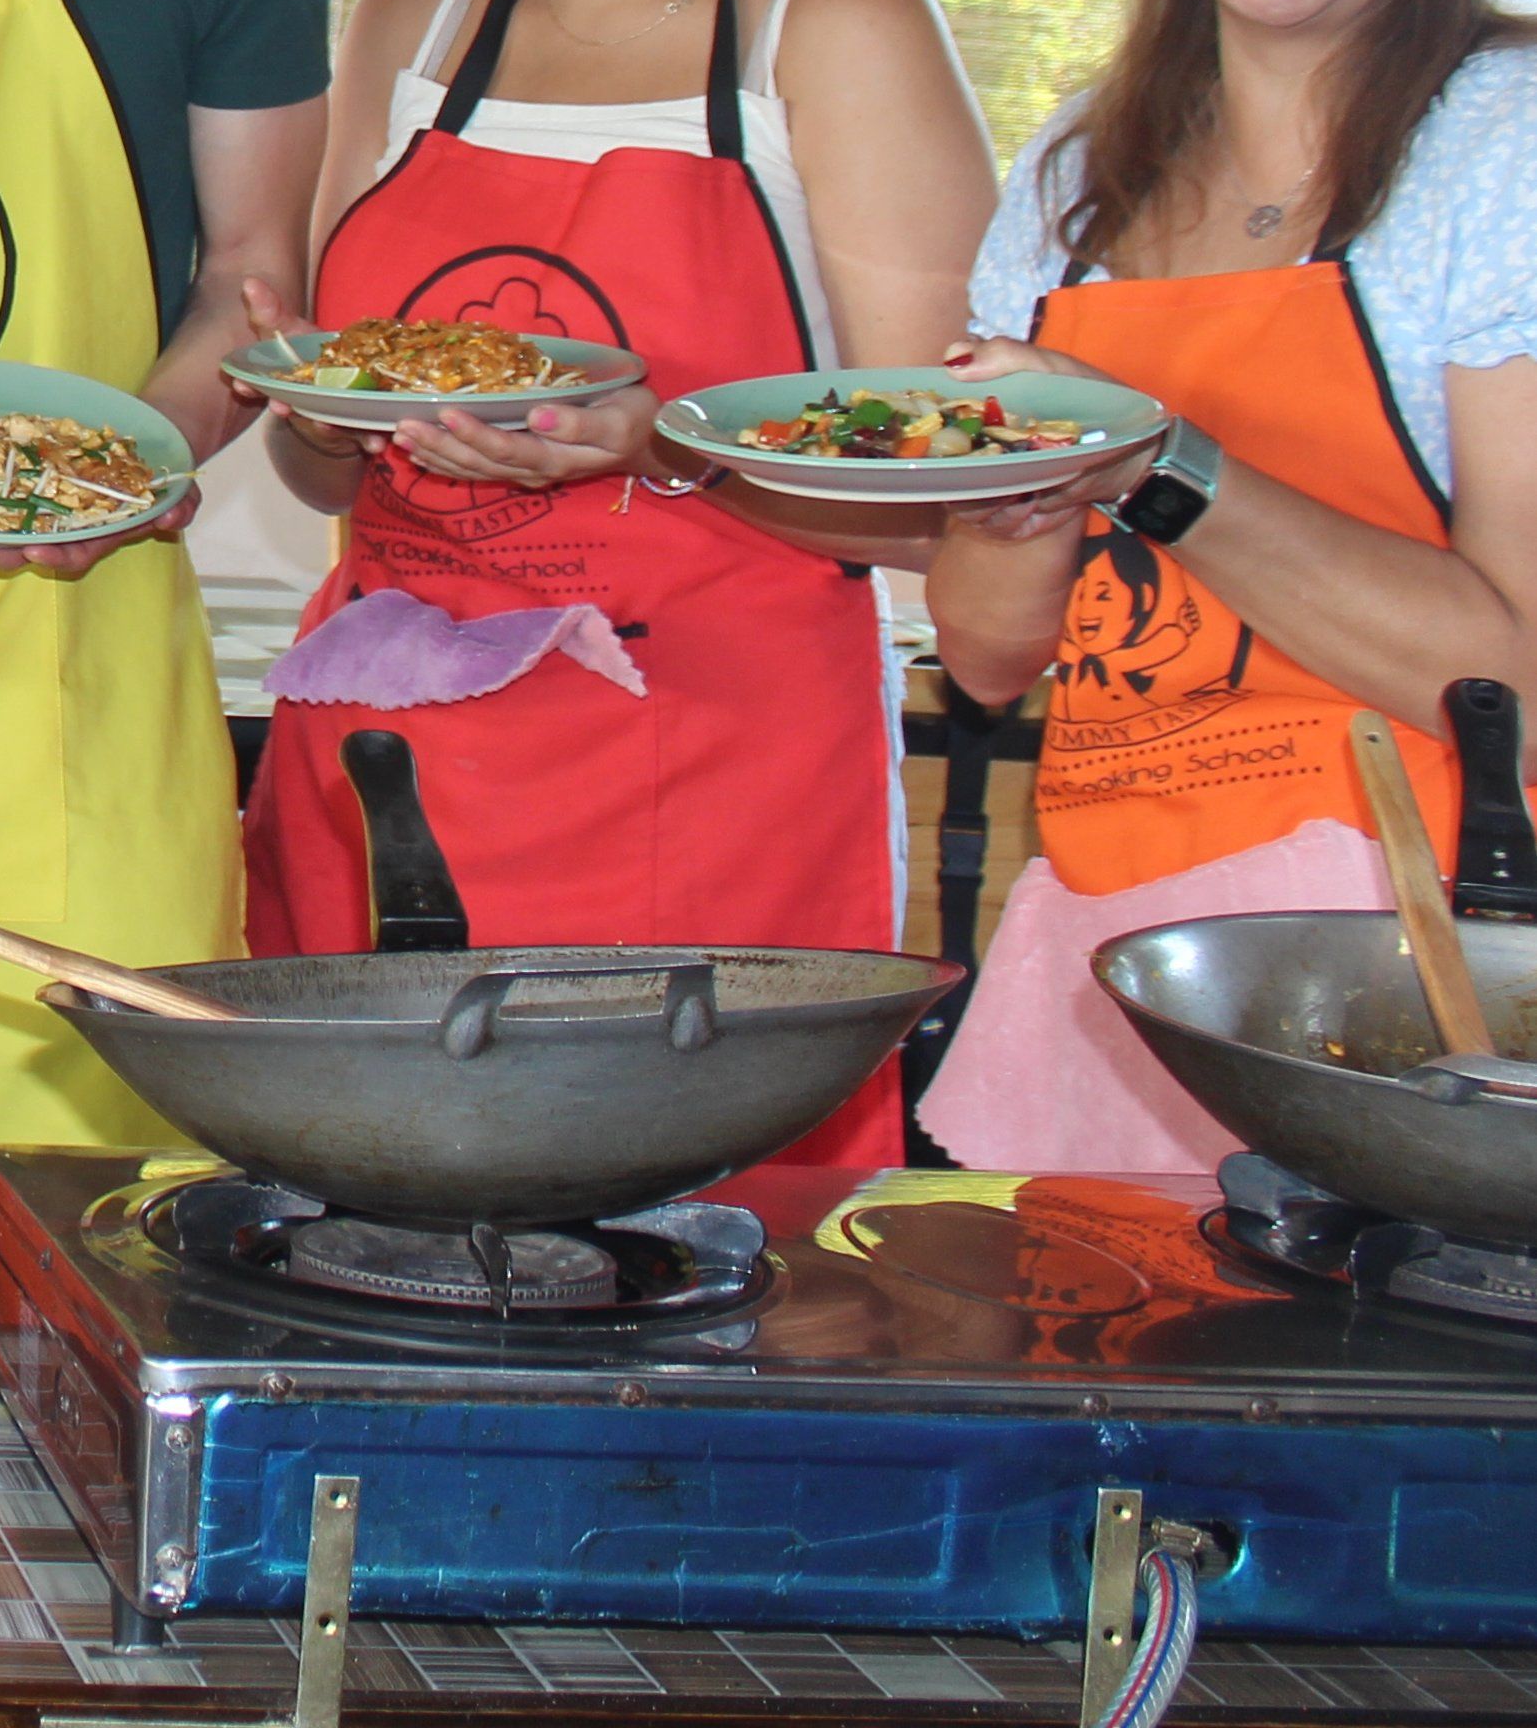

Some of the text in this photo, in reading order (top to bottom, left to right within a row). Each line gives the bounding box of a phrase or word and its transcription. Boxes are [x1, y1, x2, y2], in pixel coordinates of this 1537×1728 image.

[453, 501, 530, 539] TASTY
[489, 557, 587, 580] School
[1062, 763, 1172, 795] Cooking
[1185, 737, 1297, 773] School
